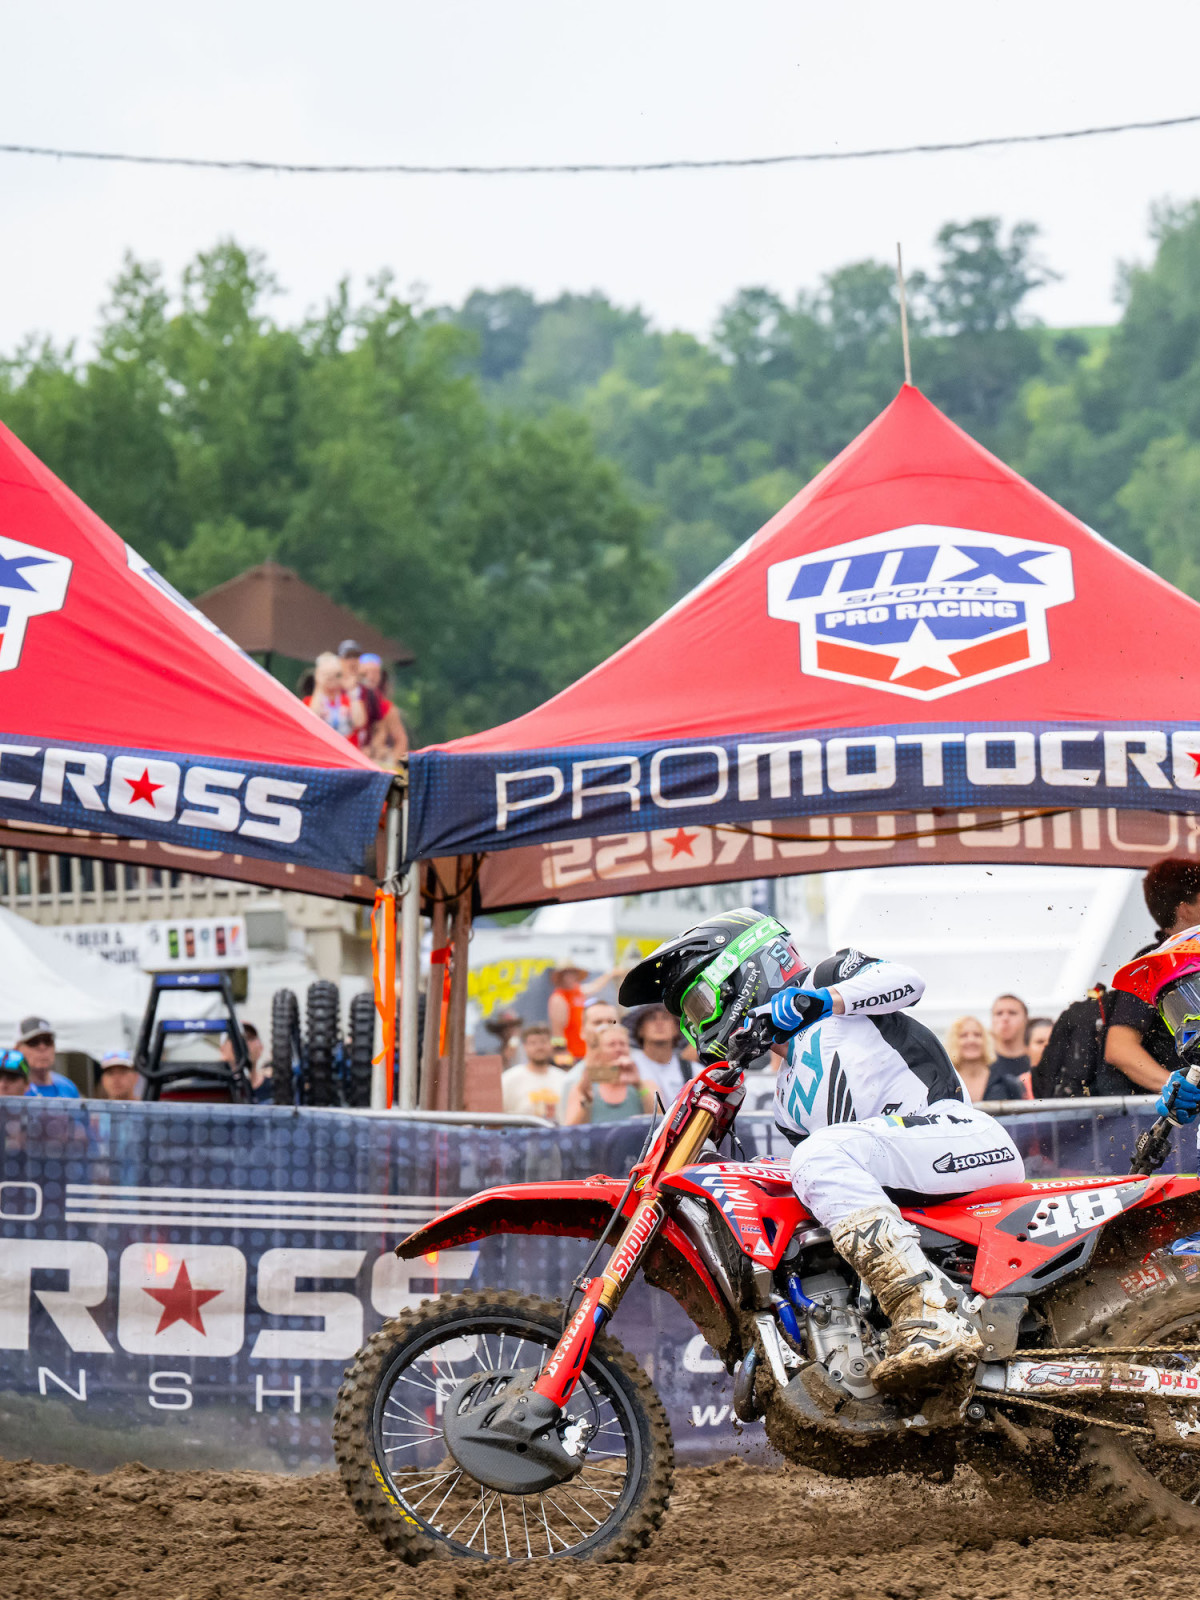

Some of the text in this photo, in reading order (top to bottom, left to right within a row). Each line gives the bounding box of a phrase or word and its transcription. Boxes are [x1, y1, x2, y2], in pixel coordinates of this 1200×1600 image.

[786, 545, 1057, 601] MX
[844, 587, 998, 605] SPORTS
[825, 601, 1018, 628] PRO RACING
[728, 967, 761, 1022] MONSTER
[851, 984, 916, 1011] HONDA
[953, 1145, 1015, 1171] HONDA
[700, 1177, 759, 1213] CRF
[1031, 1175, 1124, 1191] HONDA
[1030, 1189, 1124, 1239] 48
[611, 1205, 660, 1282] SHOWA
[546, 1298, 592, 1378] DUNLOP
